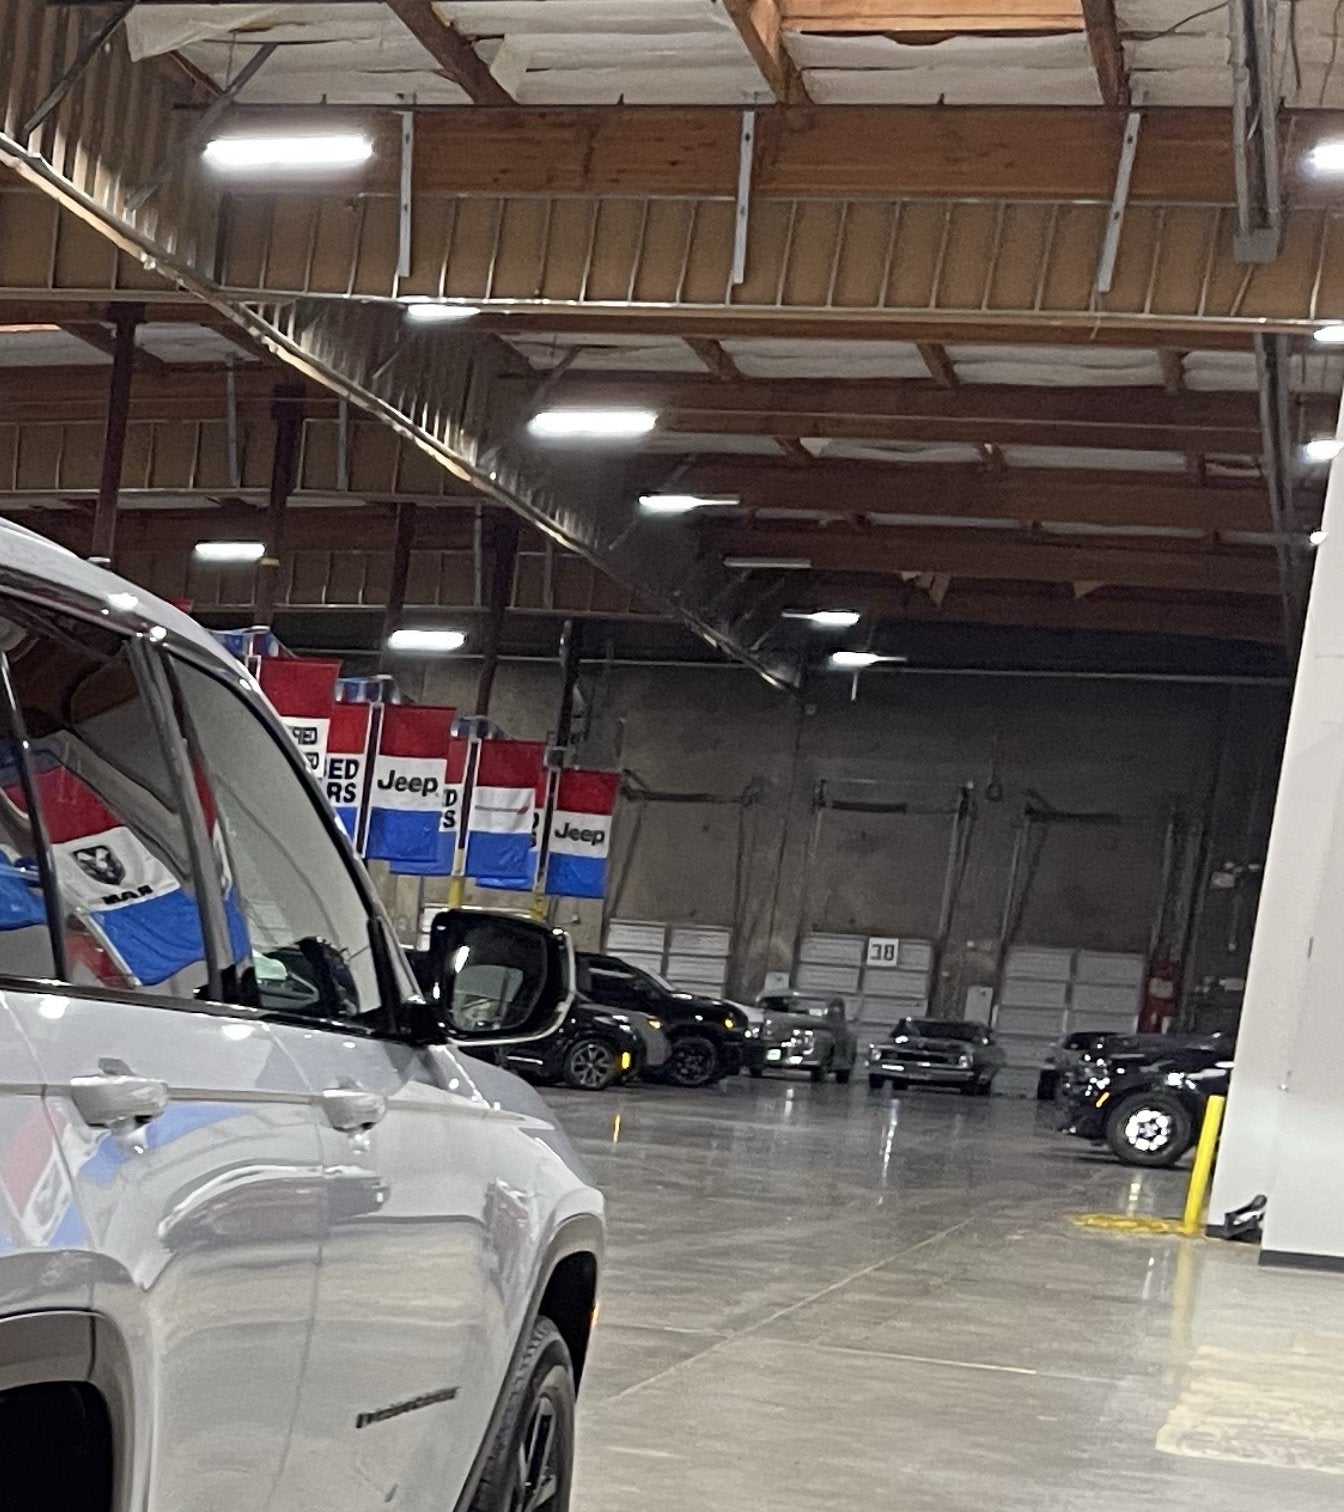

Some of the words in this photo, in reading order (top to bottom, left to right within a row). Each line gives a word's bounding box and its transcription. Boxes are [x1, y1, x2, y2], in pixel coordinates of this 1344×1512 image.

[377, 770, 439, 797] Jeep
[554, 822, 605, 846] Jeep
[870, 943, 895, 961] 38
